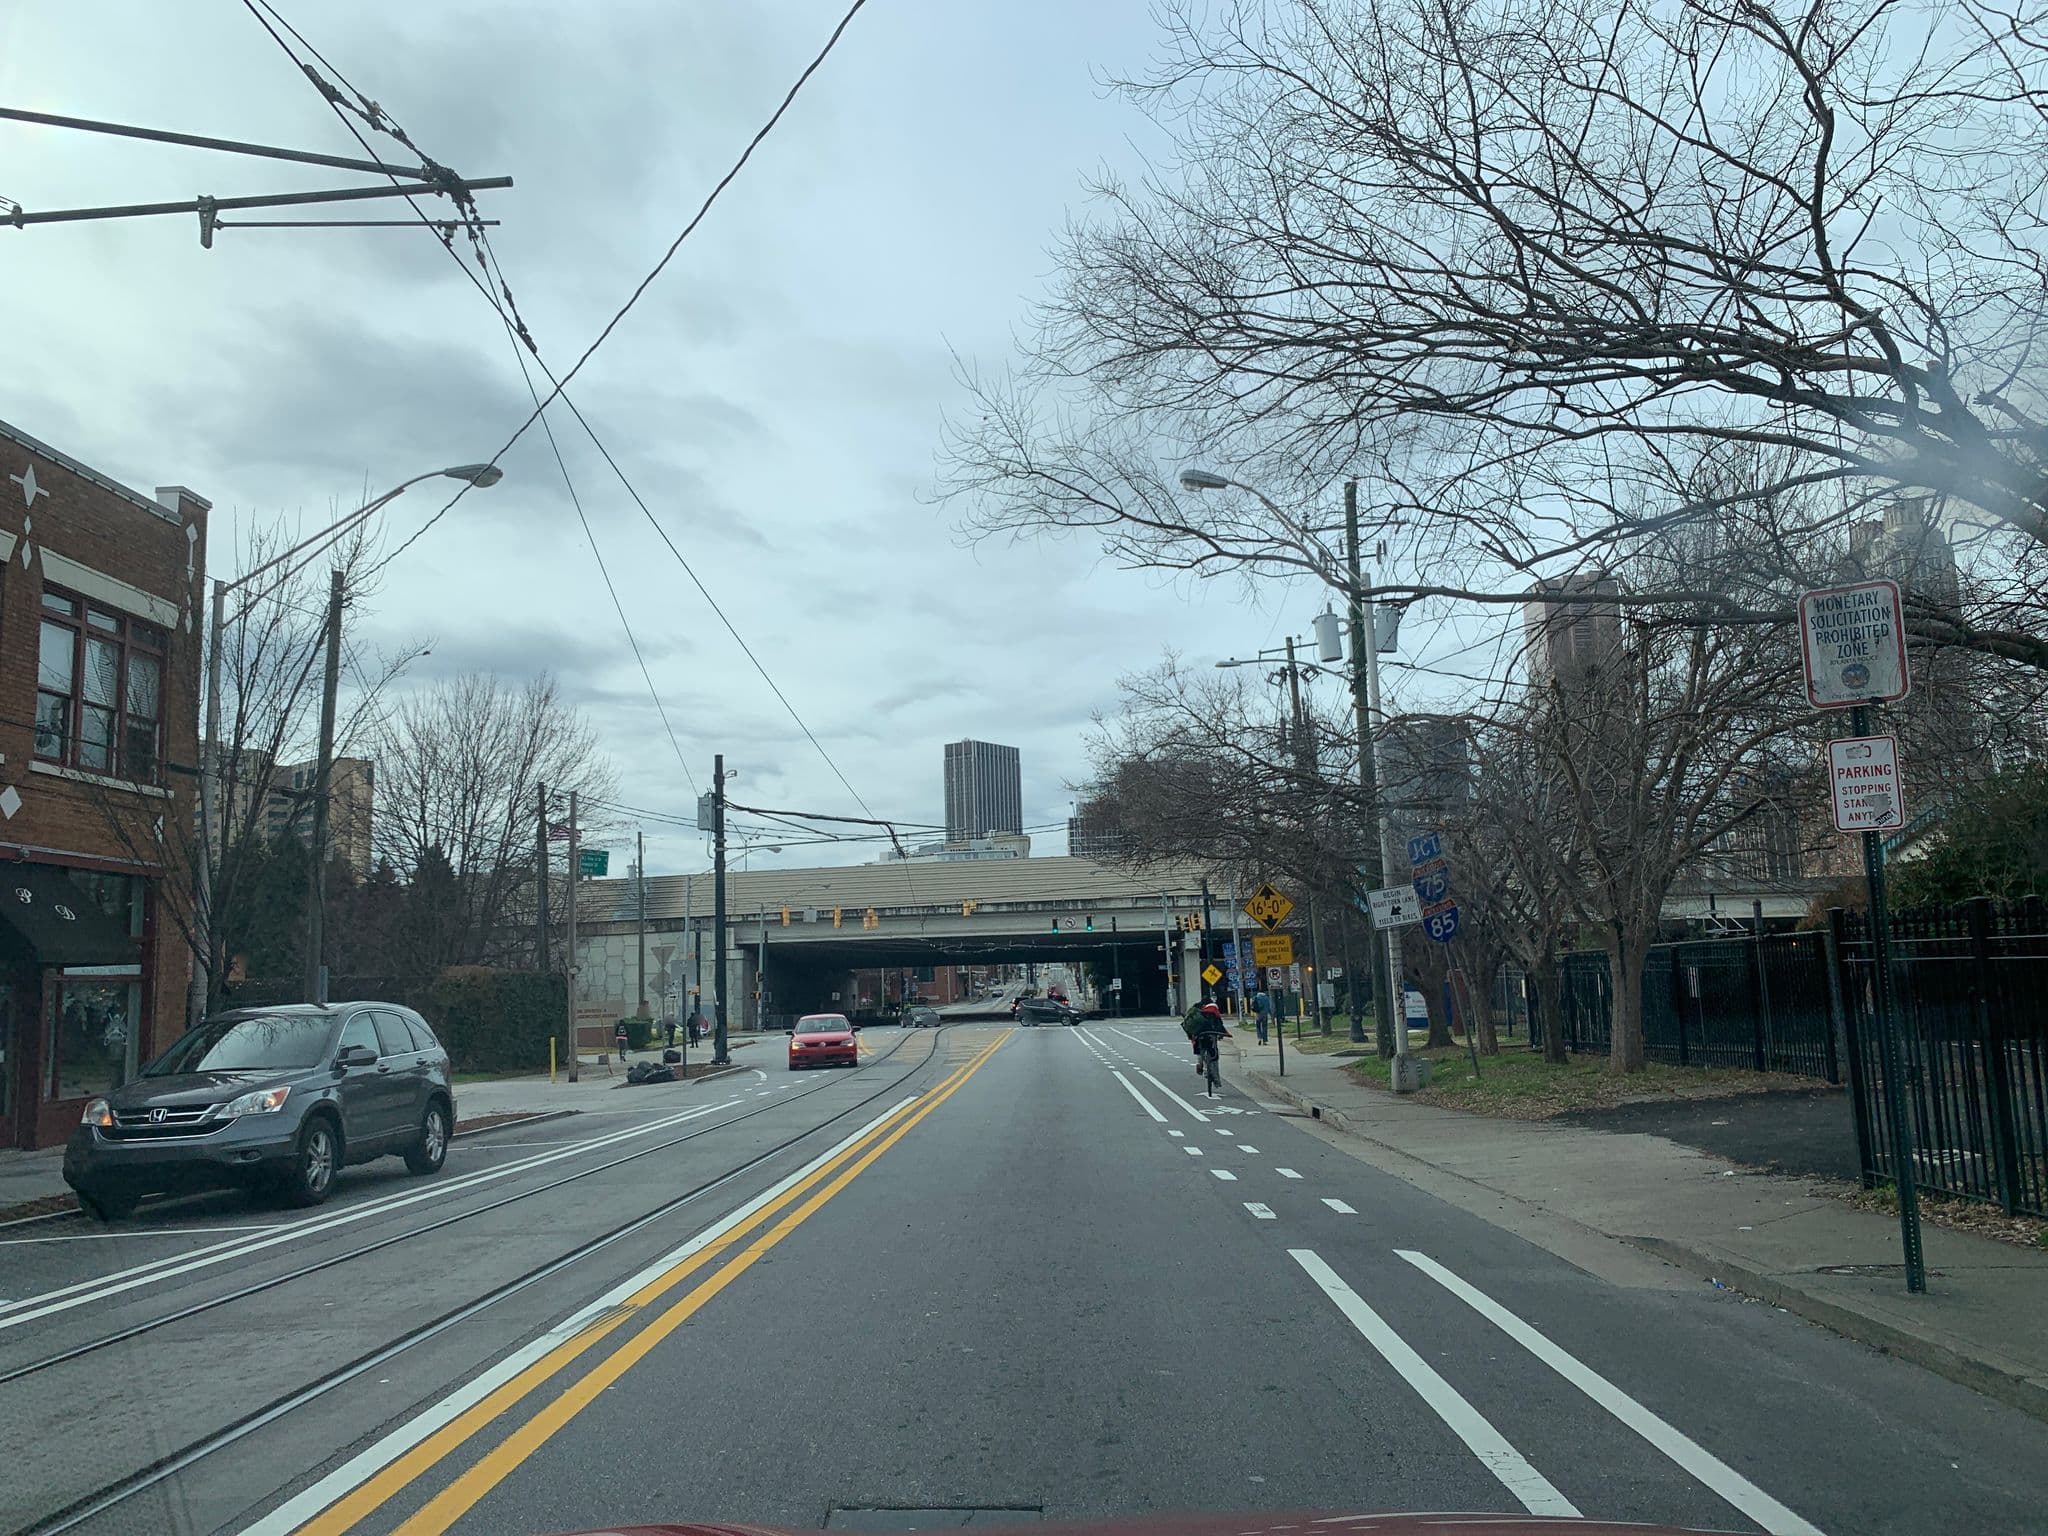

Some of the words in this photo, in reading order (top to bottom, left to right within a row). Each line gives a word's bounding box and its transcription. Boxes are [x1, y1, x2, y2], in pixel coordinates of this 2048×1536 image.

[1814, 591, 1879, 613] MONETARY
[1810, 606, 1891, 630] SOLICITATION
[1815, 623, 1889, 645] PROHIBITED
[1837, 642, 1869, 659] ZONE
[1837, 764, 1892, 779] PARKING
[1841, 783, 1892, 796] STOPPING
[1412, 836, 1439, 861] JCT
[1420, 873, 1445, 897] 75
[1383, 890, 1401, 898] BEGIN
[1372, 899, 1389, 908] RIGHT
[1379, 917, 1394, 925] YIELD
[1431, 912, 1455, 937] 85
[1226, 960, 1236, 968] 75
